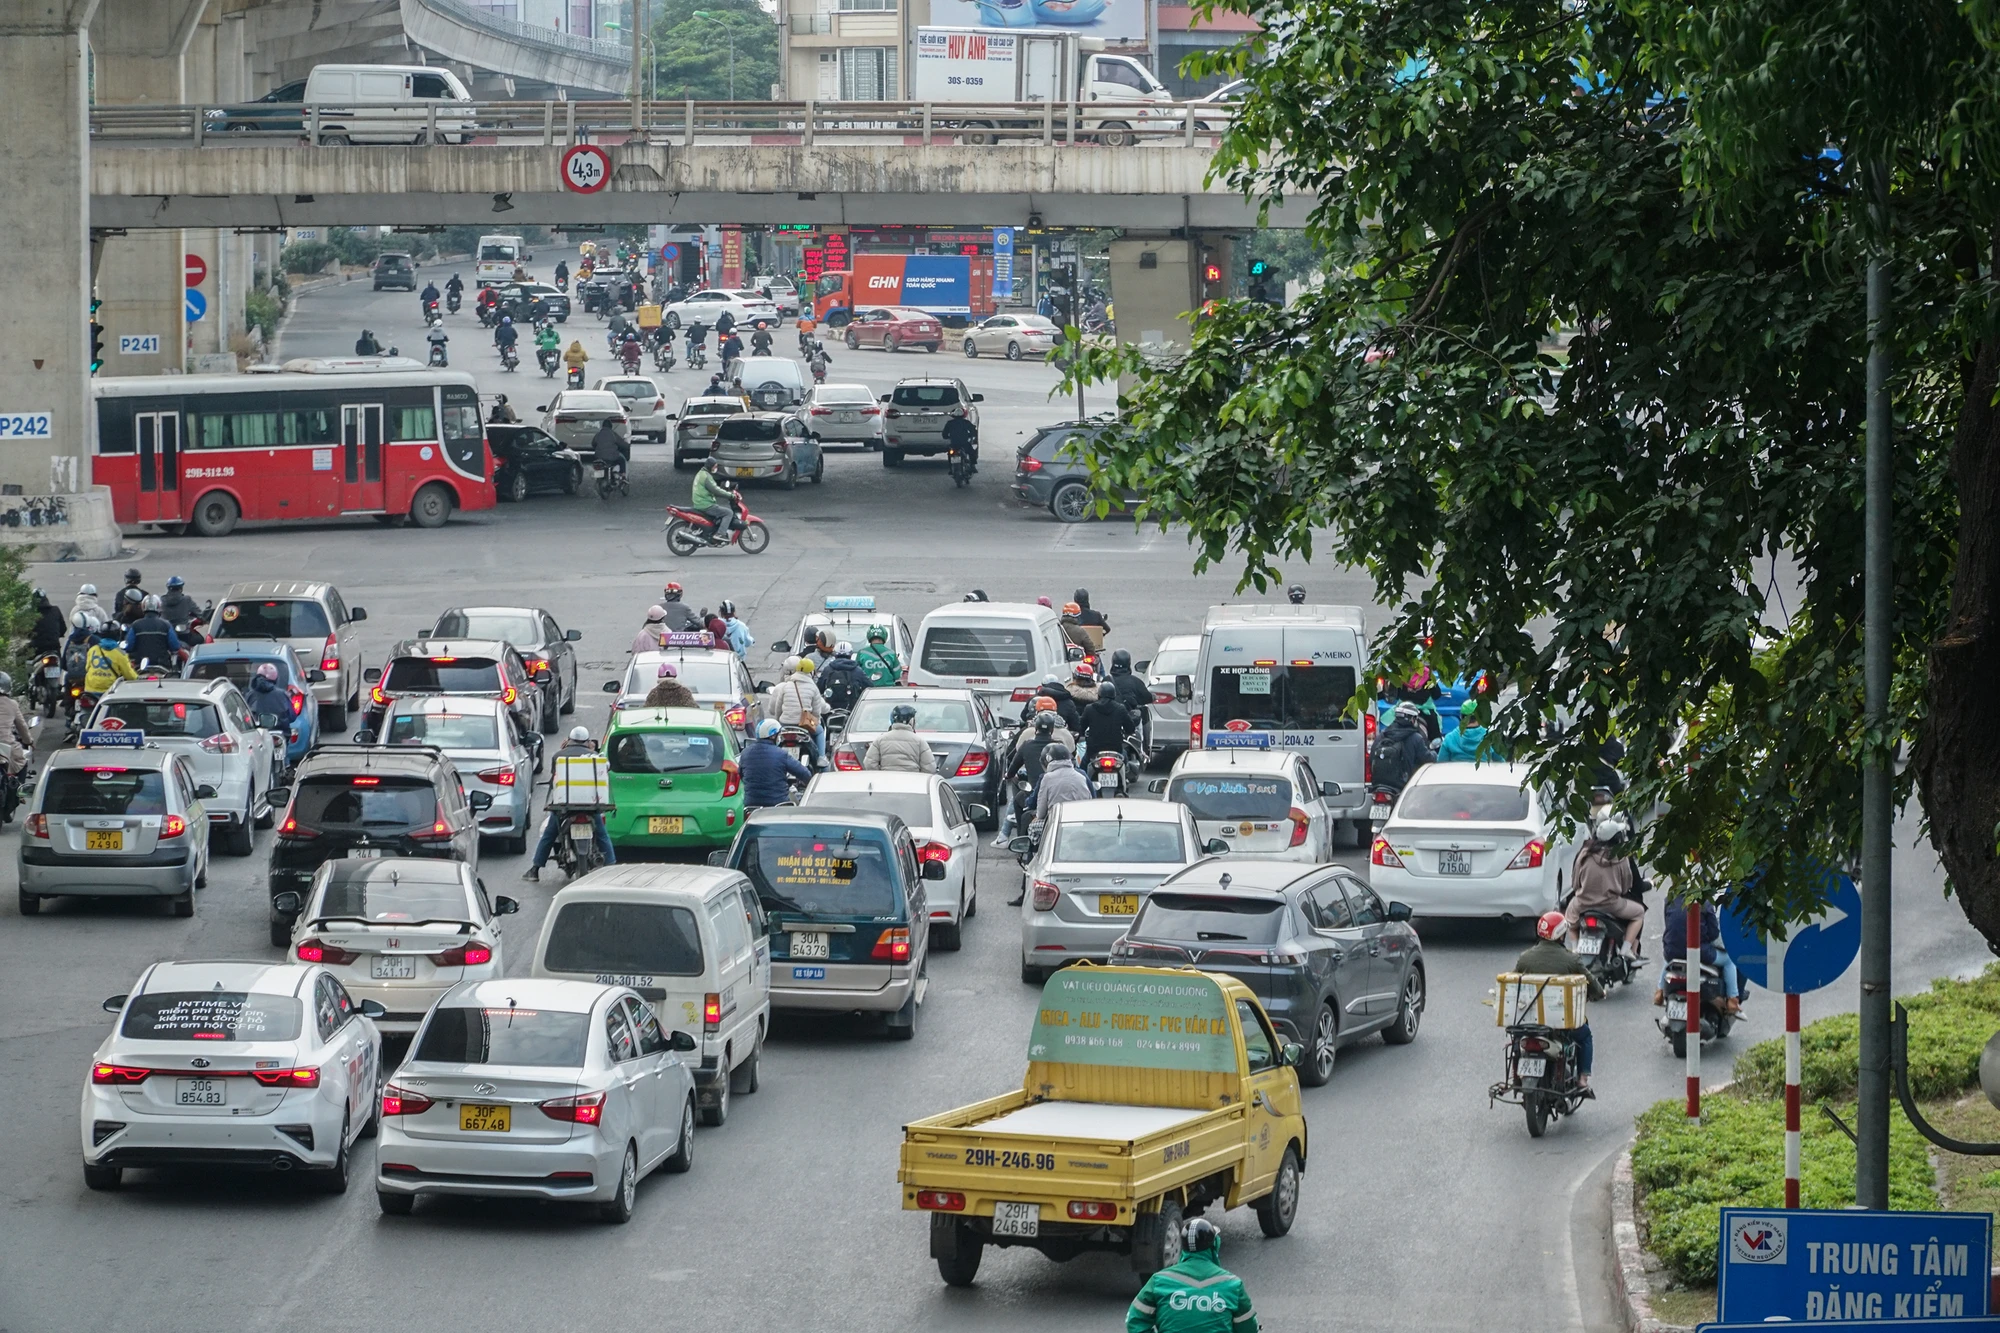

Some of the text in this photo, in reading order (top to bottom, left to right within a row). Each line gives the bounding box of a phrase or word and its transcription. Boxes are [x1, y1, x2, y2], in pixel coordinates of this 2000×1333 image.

[937, 36, 946, 44] KEM
[948, 35, 986, 60] HUY ANH
[572, 158, 600, 181] 4,3m
[868, 276, 900, 288] GHN
[121, 338, 158, 352] P241
[0, 416, 48, 436] P242
[1232, 668, 1248, 676] HỢP
[1284, 736, 1314, 746] 204.42
[1248, 784, 1277, 794] Taxi
[90, 841, 118, 849] 7490
[778, 855, 800, 869] NHẬN
[816, 858, 827, 867] SƠ
[842, 860, 852, 868] XE
[1447, 852, 1463, 862] 30A
[1440, 863, 1470, 873] 715.00
[1110, 896, 1127, 904] 30A
[1103, 905, 1134, 914] 914.75
[801, 933, 819, 944] 30A
[793, 944, 827, 956] 543.79
[384, 958, 402, 967] 30H
[376, 968, 410, 977] 341.17
[595, 975, 653, 987] 29D-301.52
[216, 1008, 242, 1016] thay
[154, 1022, 177, 1030] anh
[227, 1022, 265, 1031] OFFB
[1079, 1012, 1101, 1029] ALU
[1111, 1013, 1149, 1031] FOMEX
[1159, 1016, 1182, 1033] PVC
[1185, 1014, 1208, 1035] VÂN
[1065, 1035, 1086, 1046] 0938
[1108, 1037, 1123, 1047] 168
[1179, 1040, 1200, 1051] 8999
[191, 1081, 212, 1091] 30G
[182, 1093, 220, 1103] 854.83
[475, 1107, 496, 1118] 30F
[465, 1119, 505, 1130] 667.48
[965, 1148, 1055, 1171] 29H-246.96
[1005, 1204, 1029, 1219] 29H
[995, 1219, 1037, 1235] 246.96
[1773, 1227, 1782, 1238] NAM
[1735, 1244, 1782, 1259] VIETNAM REGISTER
[1806, 1236, 1968, 1276] TRUNG TÂM
[1170, 1290, 1227, 1313] Grab
[1806, 1280, 1964, 1320] ĐĂNG KIỂM
